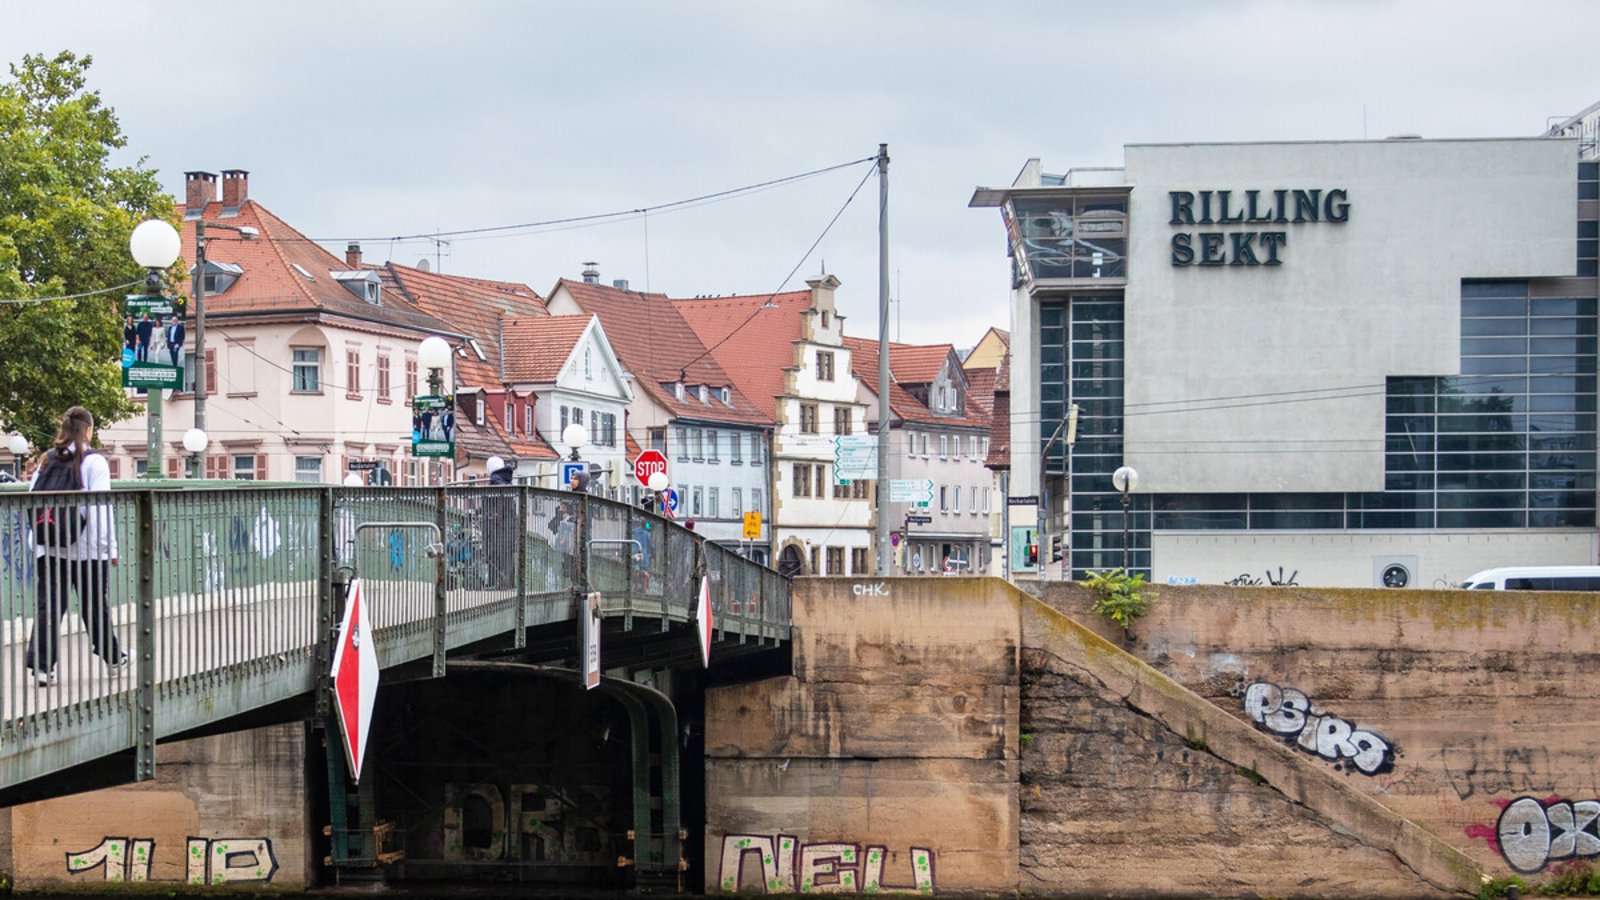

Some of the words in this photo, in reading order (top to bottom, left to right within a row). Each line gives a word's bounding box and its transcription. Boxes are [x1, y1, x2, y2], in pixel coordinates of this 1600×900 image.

[1168, 188, 1352, 225] RILLING
[1171, 231, 1287, 267] SEKT
[637, 461, 665, 477] STOP
